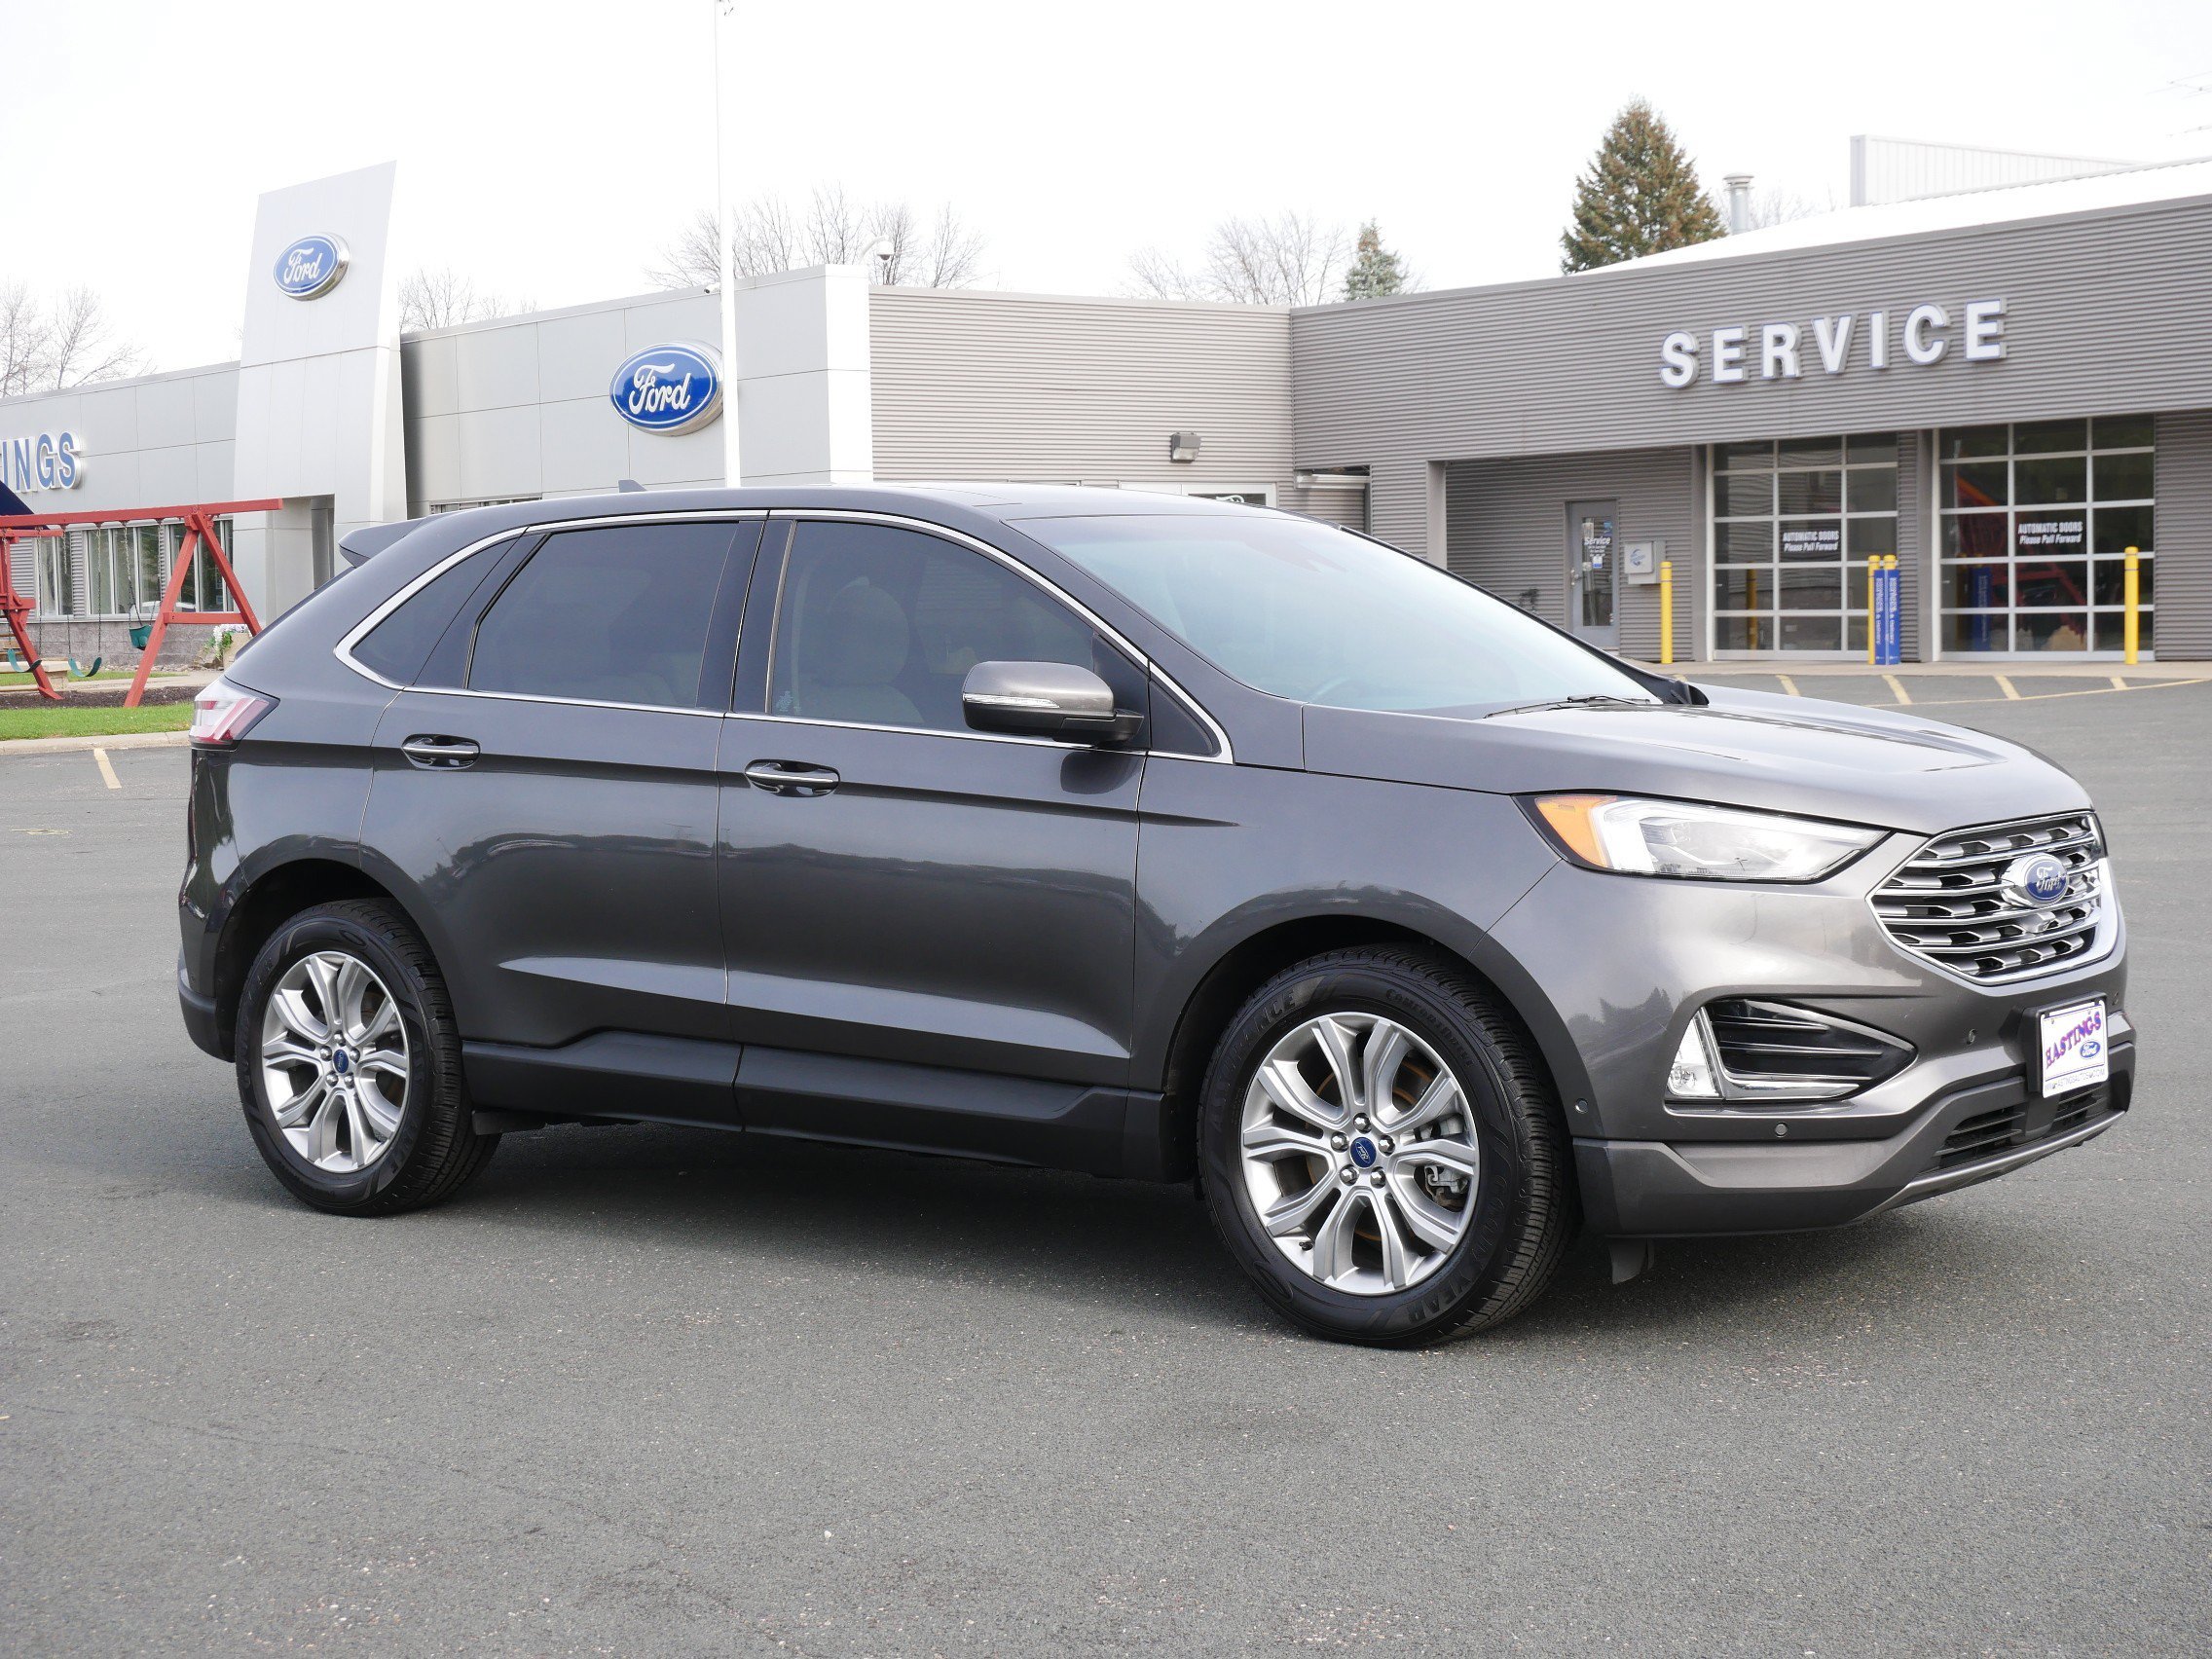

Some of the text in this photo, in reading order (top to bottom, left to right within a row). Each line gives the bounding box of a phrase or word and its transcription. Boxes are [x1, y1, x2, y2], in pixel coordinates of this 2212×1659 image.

[283, 246, 323, 284] Ford
[1659, 298, 2007, 388] SERVICE
[628, 363, 692, 415] Ford
[1, 430, 78, 492] INGS
[1783, 530, 1840, 542] AUTOMATIC DOORS
[2018, 521, 2083, 535] AUTOMATIC DOORS
[1584, 536, 1611, 545] Service
[1784, 541, 1839, 552] Please Pull Forward
[2019, 534, 2082, 545] Please Pull Forward
[2036, 866, 2061, 894] Ford
